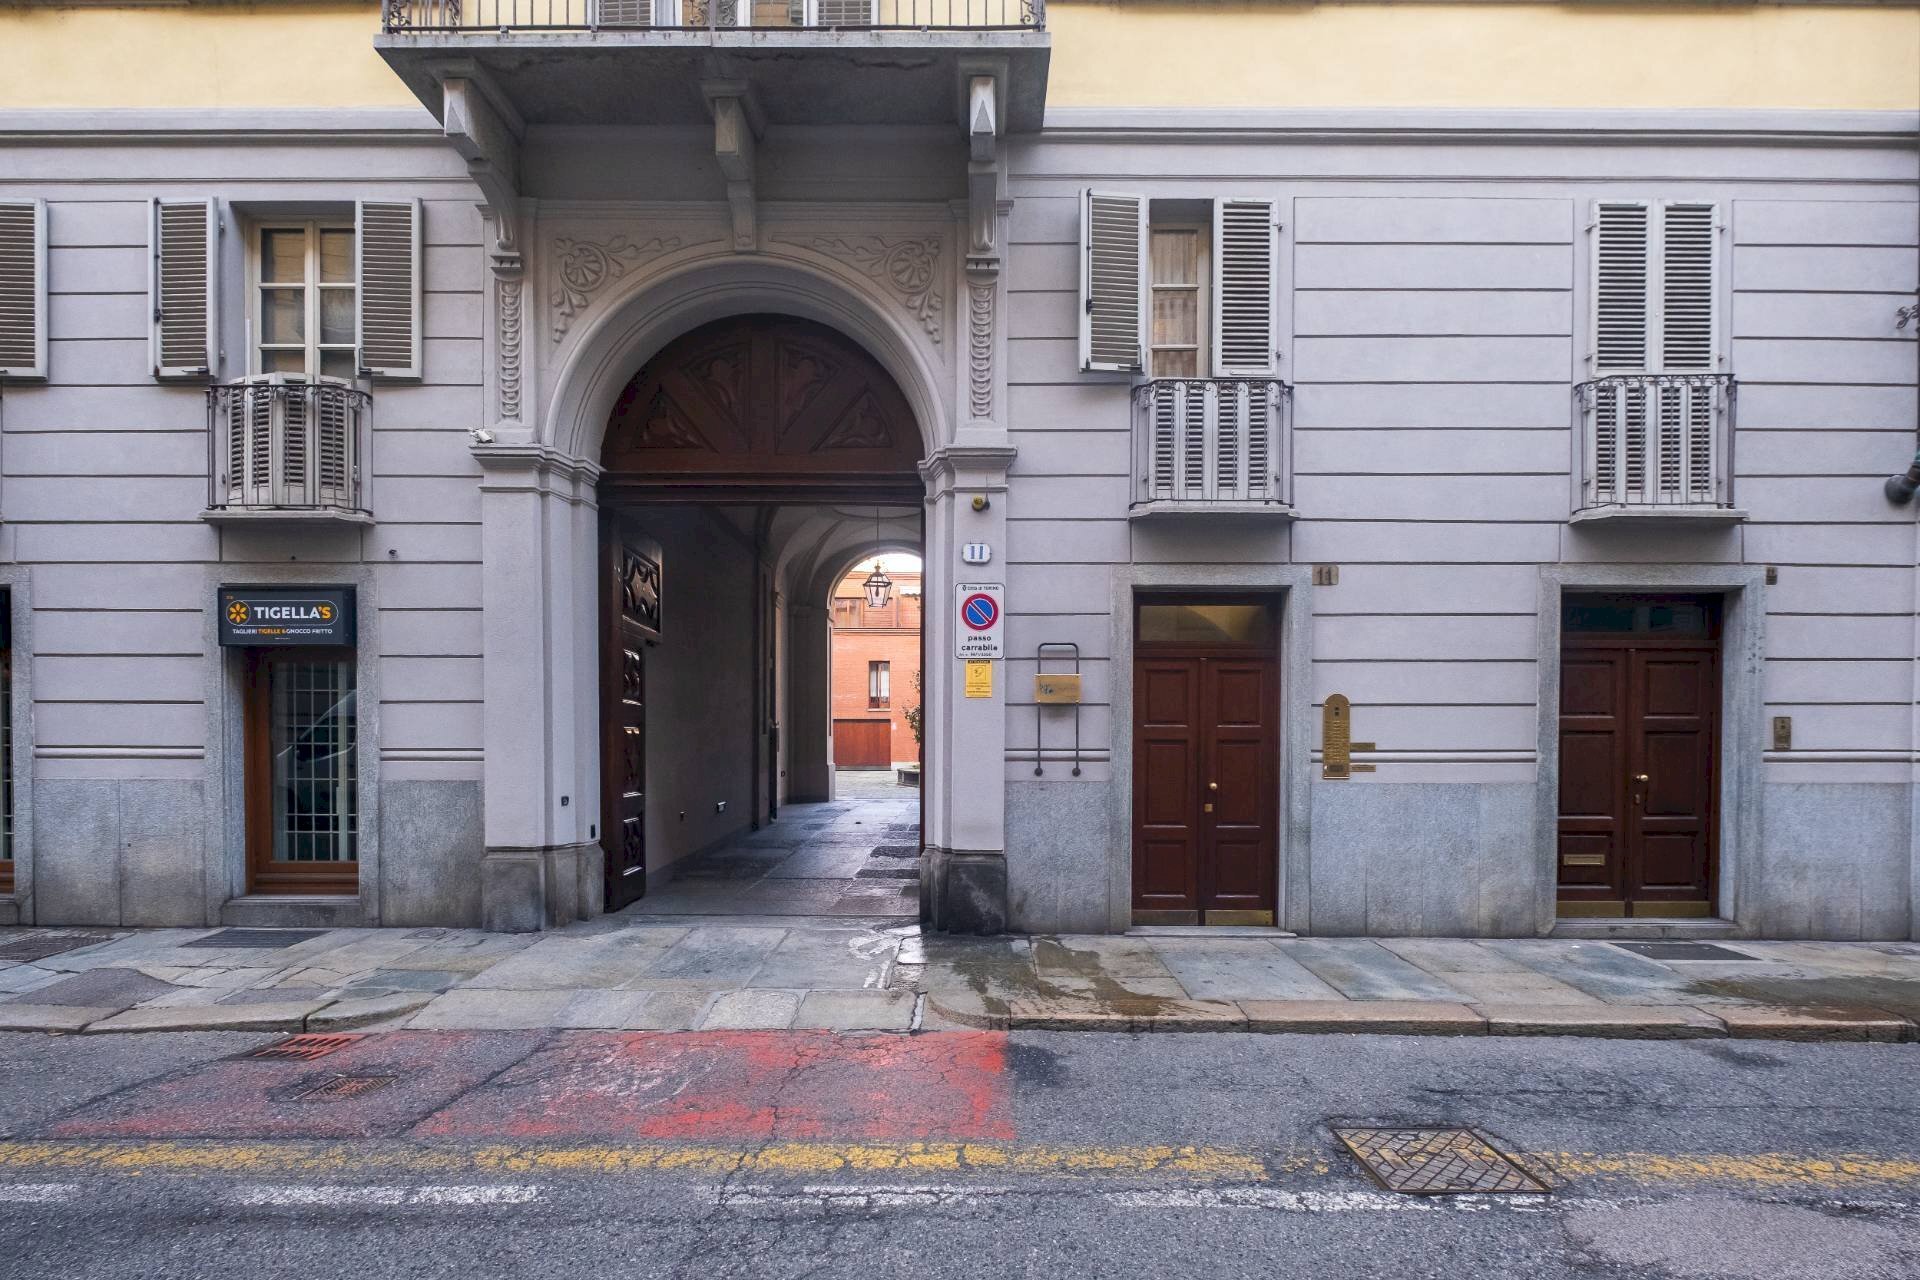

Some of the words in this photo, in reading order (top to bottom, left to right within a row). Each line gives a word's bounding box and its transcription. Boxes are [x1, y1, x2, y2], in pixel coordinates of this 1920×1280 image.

[970, 545, 984, 560] 11
[1316, 566, 1330, 581] 11
[253, 606, 331, 619] TIGELLA'S
